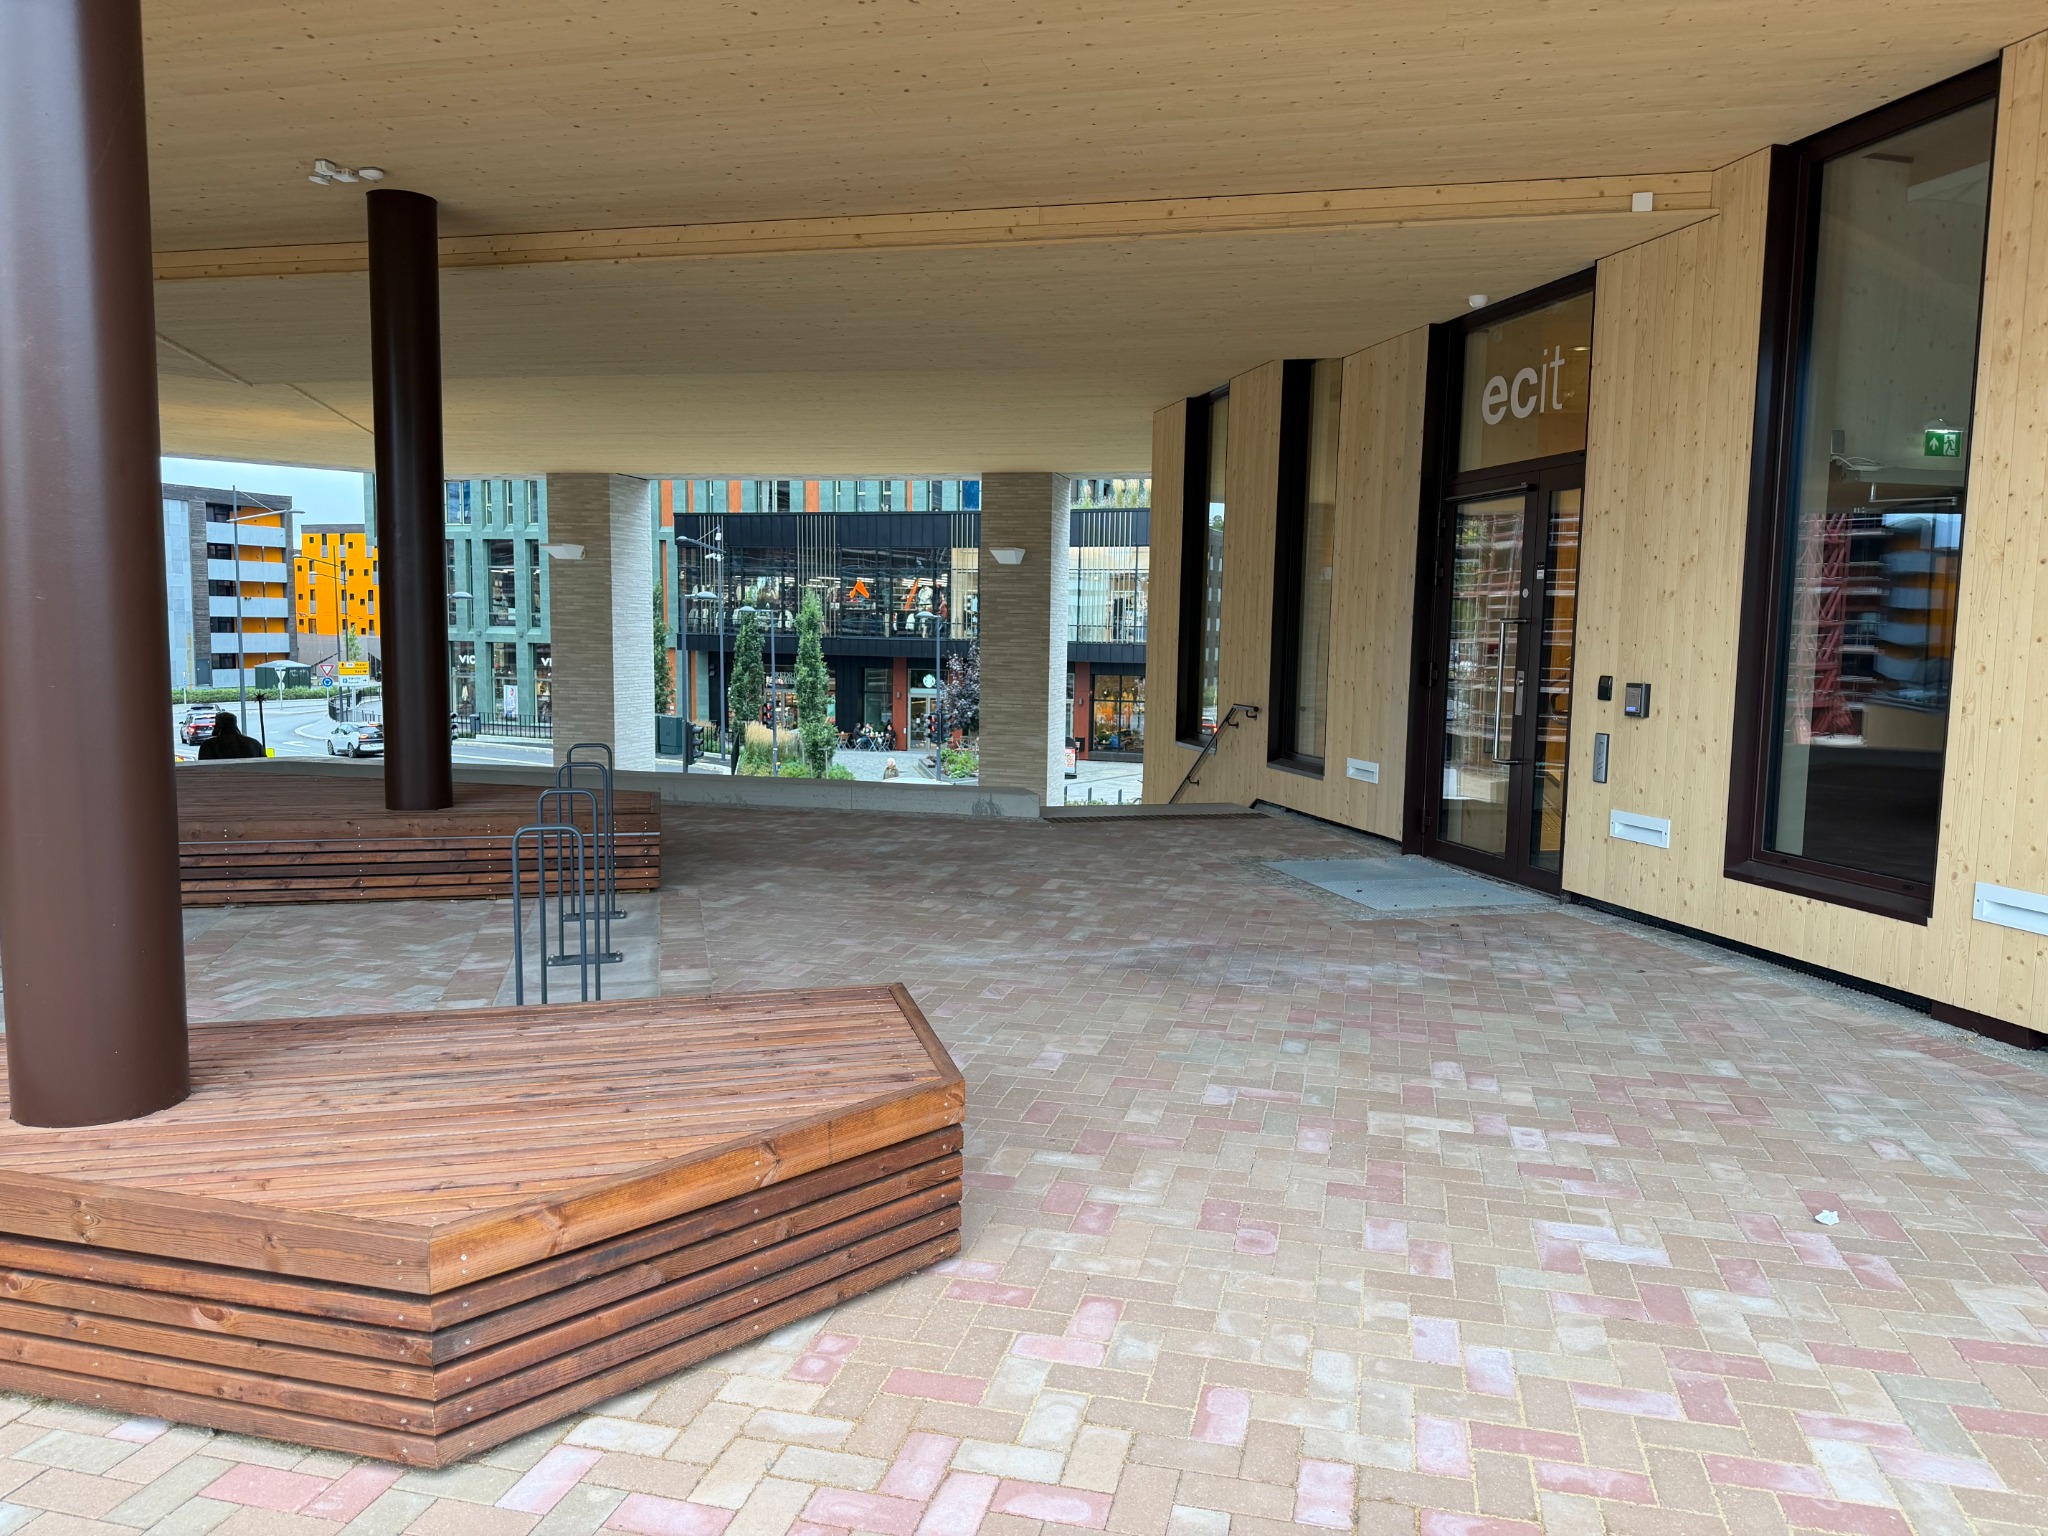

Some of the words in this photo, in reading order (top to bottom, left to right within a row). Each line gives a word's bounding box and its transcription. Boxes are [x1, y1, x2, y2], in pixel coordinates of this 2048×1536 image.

[1482, 345, 1565, 425] ecit
[458, 655, 476, 665] VIC
[541, 657, 552, 667] VI
